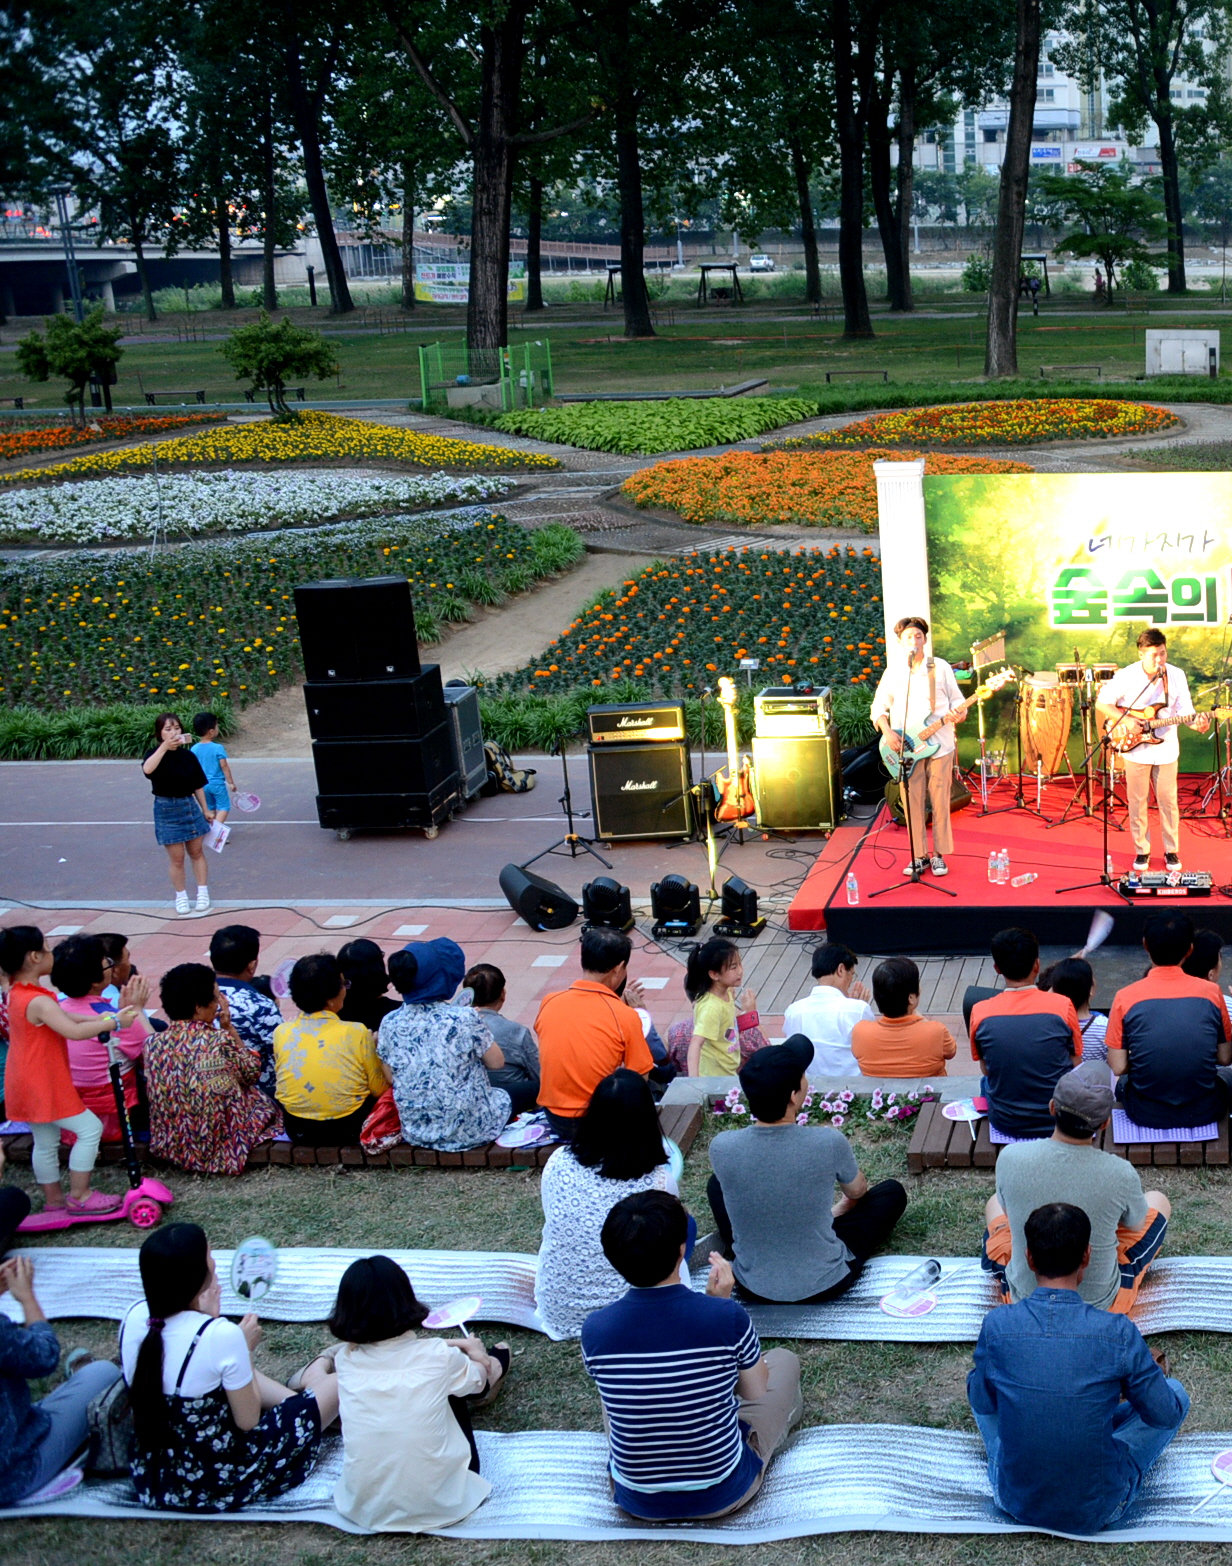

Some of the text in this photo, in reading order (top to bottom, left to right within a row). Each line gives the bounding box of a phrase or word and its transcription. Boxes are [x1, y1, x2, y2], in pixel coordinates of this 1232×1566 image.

[1052, 568, 1217, 625] 숲속의
[616, 717, 654, 728] Marshall
[620, 780, 658, 791] Marshall
